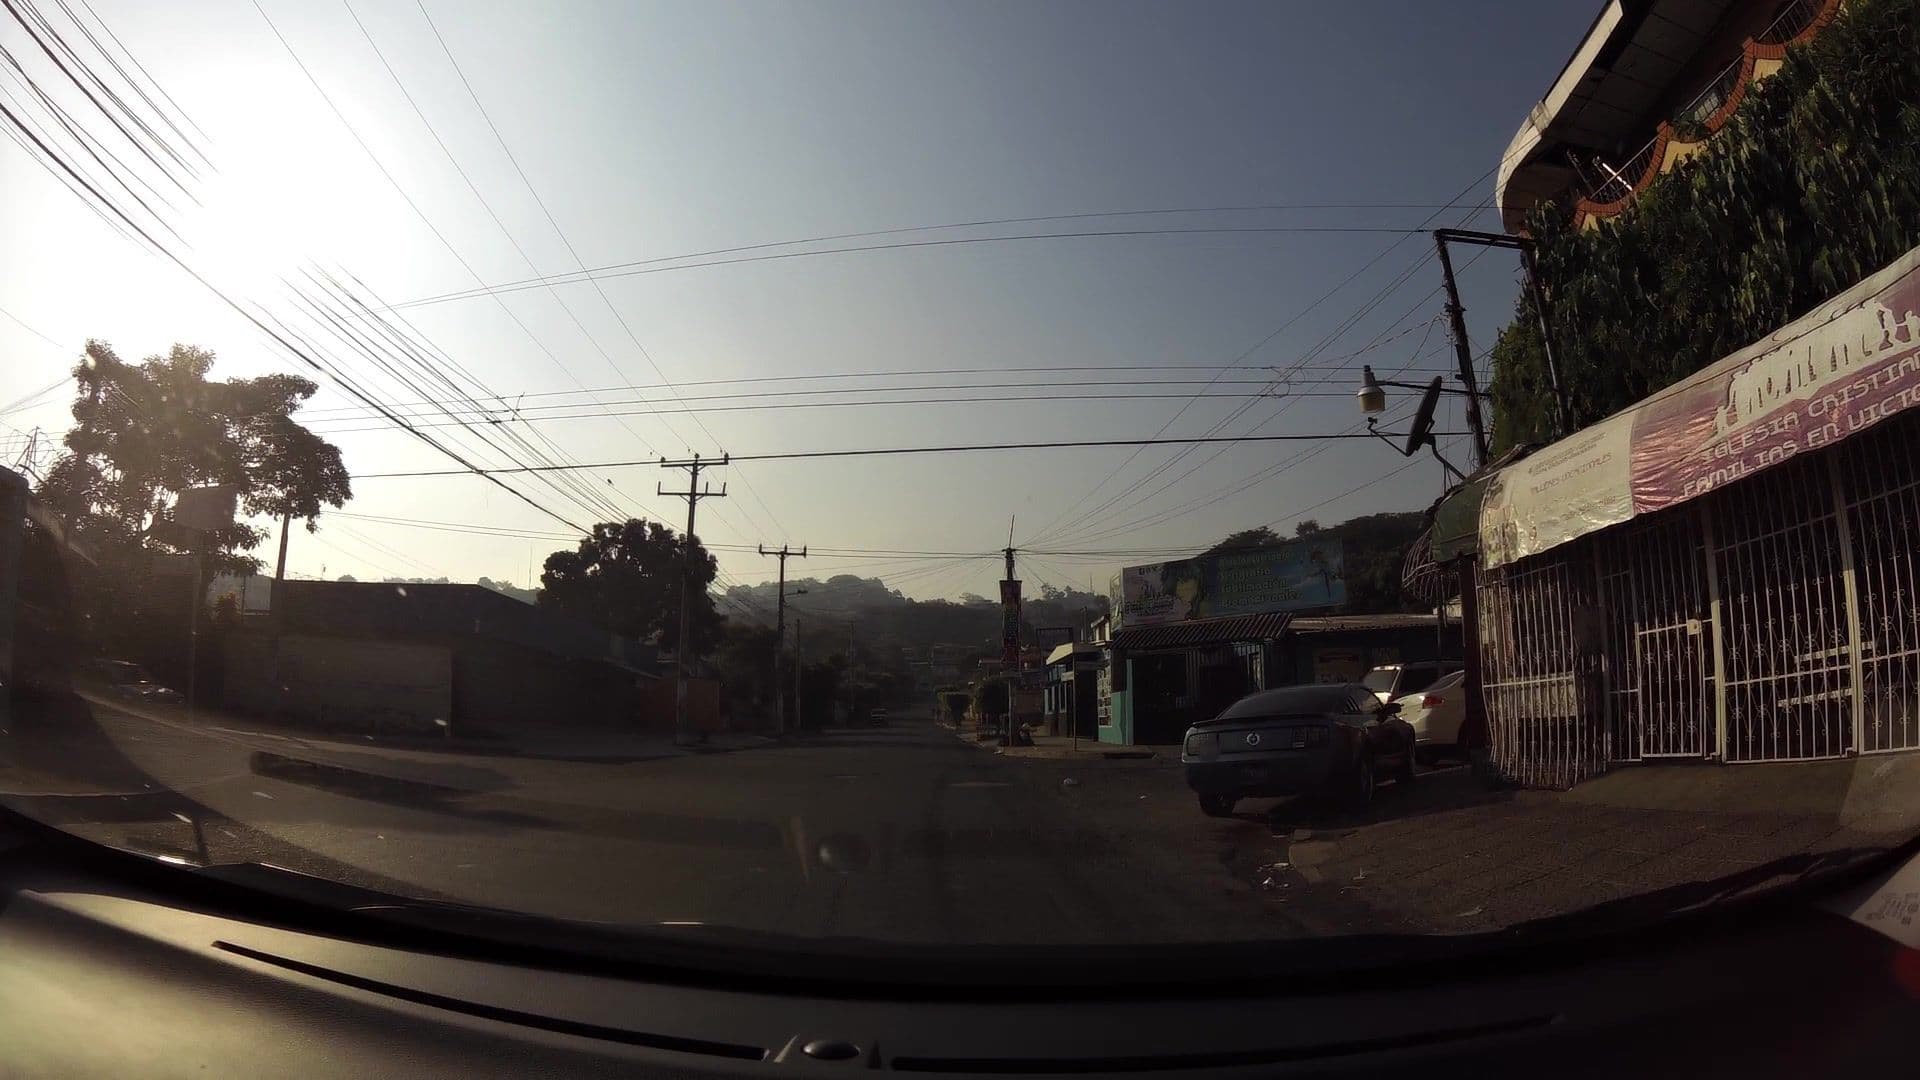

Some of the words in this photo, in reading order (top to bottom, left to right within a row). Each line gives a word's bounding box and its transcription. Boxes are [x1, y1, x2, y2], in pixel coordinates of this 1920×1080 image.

[1682, 439, 1799, 499] FAMILIAS
[1807, 422, 1841, 447] EN
[1701, 411, 1800, 465] IGLESIA
